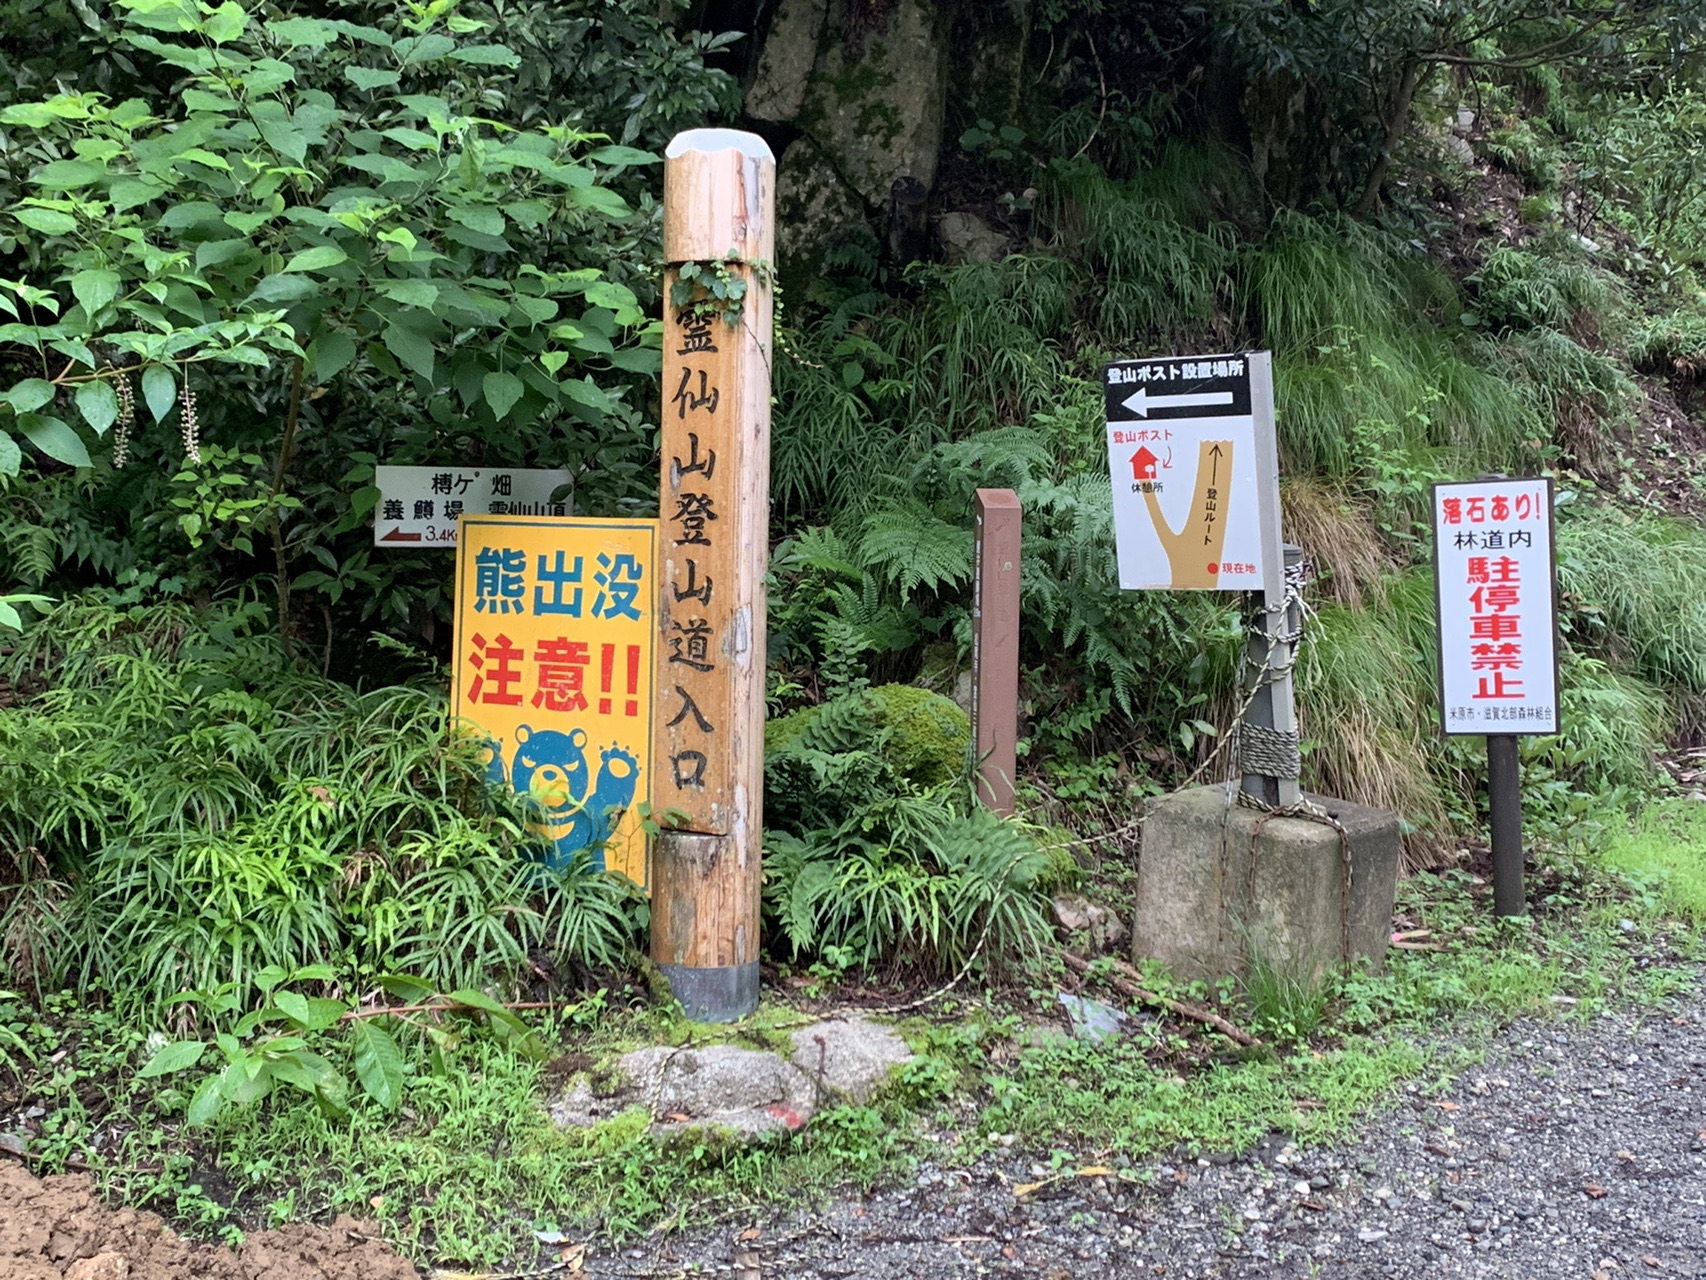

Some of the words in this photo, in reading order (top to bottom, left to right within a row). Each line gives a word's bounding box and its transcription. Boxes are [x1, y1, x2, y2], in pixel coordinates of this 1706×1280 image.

[1107, 359, 1244, 384] 登山ポスト設置場所
[1113, 429, 1173, 444] 登山ポスト
[1131, 482, 1164, 493] 休憩所
[383, 499, 464, 520] 養鱒場
[1204, 488, 1218, 546] 登山ルート
[1453, 529, 1532, 550] 林道内
[1222, 563, 1256, 574] 現在地
[473, 546, 643, 622] 熊出没
[1466, 556, 1525, 699] 駐停車禁止
[467, 632, 641, 717] 注意!!
